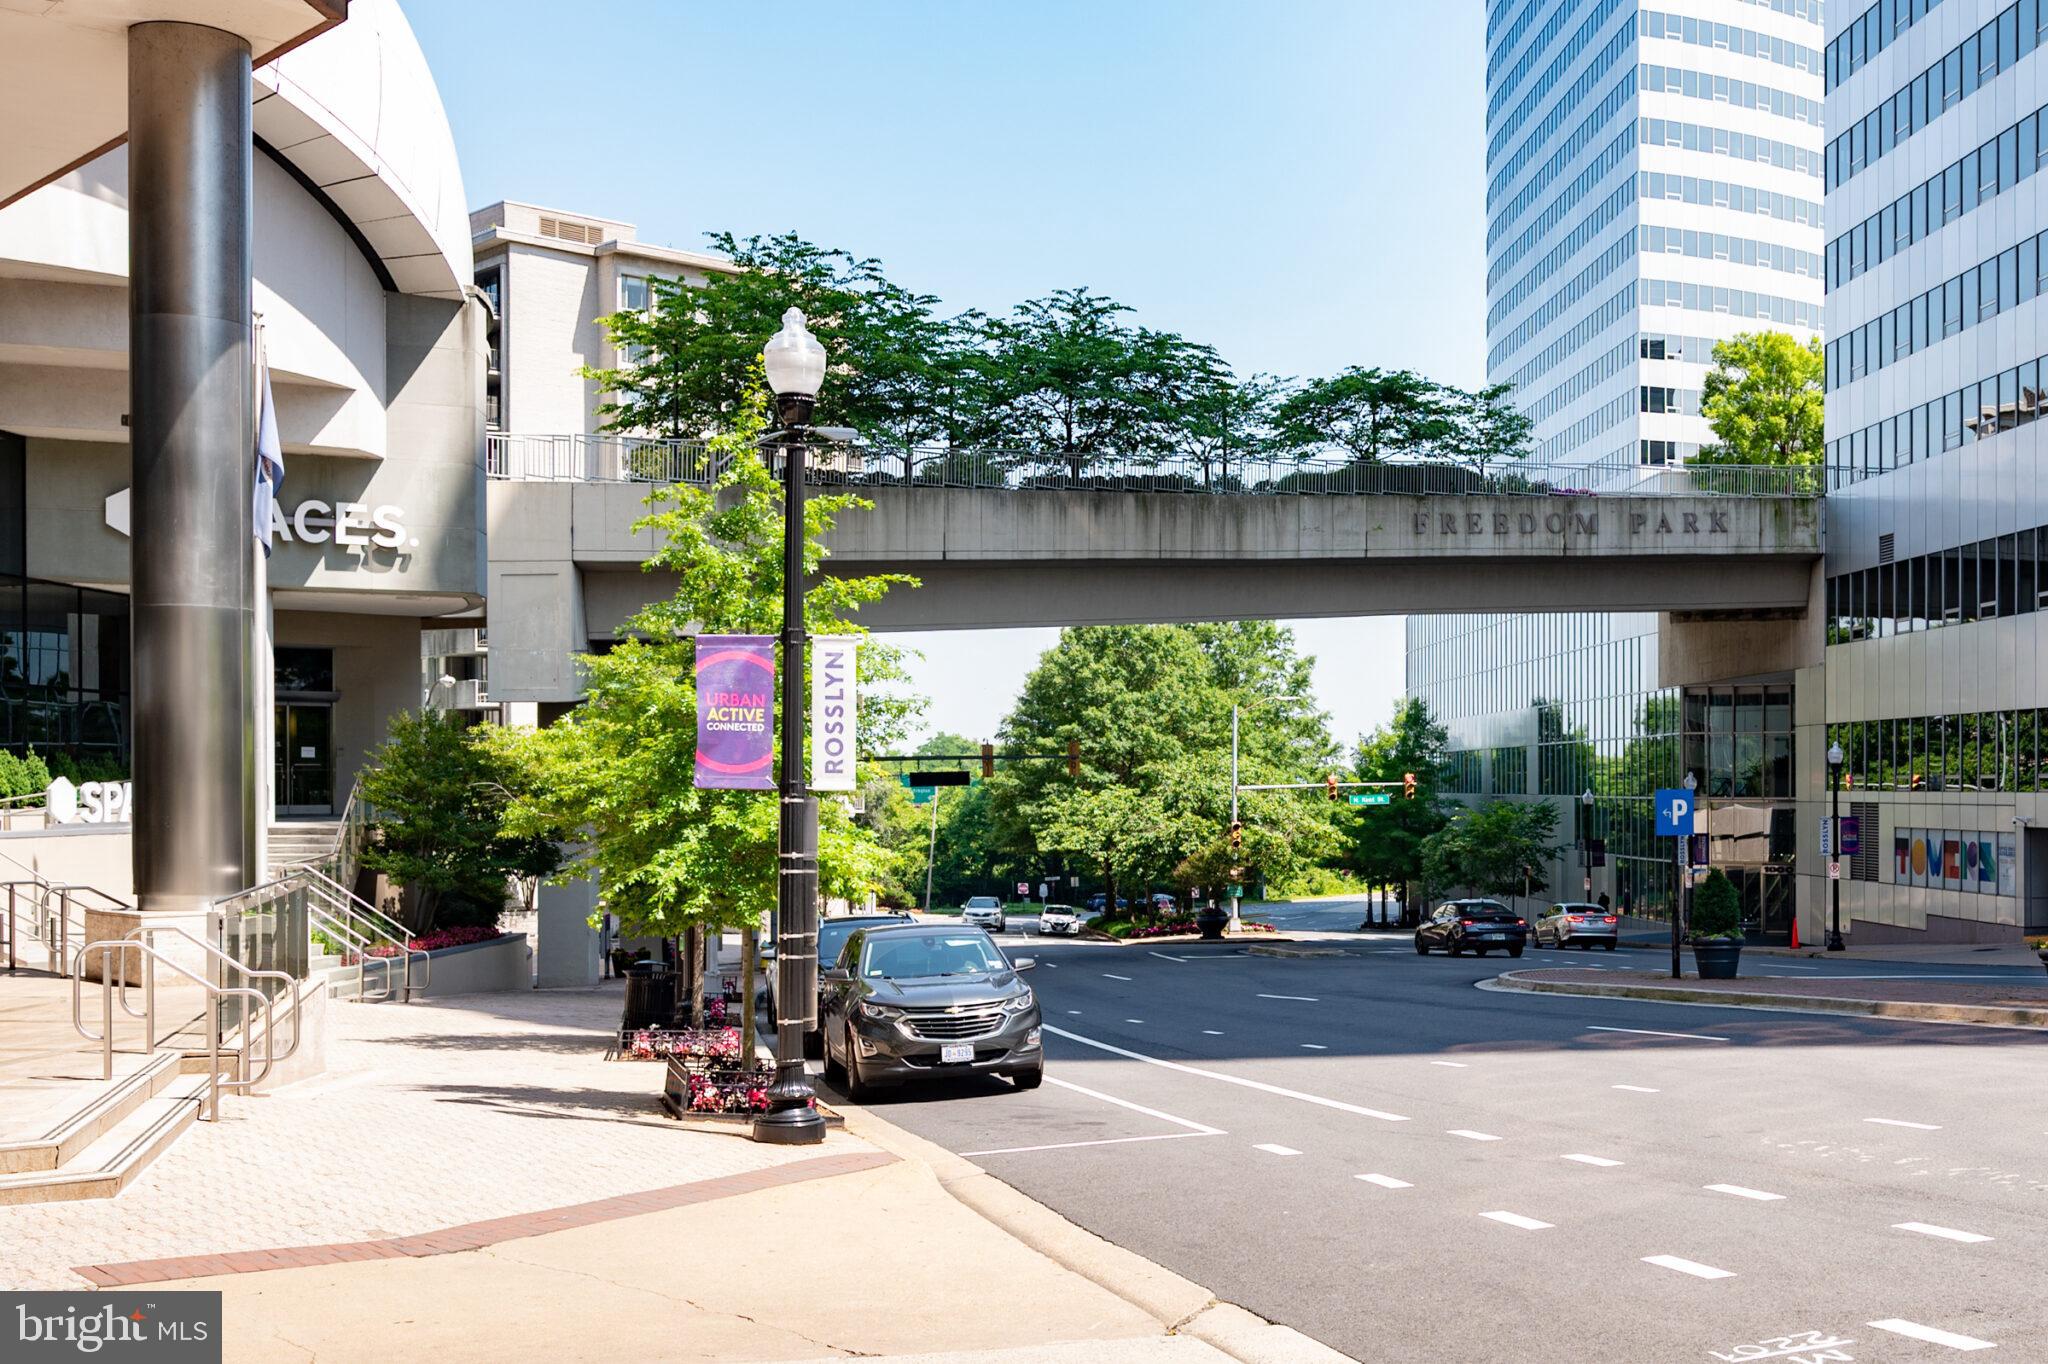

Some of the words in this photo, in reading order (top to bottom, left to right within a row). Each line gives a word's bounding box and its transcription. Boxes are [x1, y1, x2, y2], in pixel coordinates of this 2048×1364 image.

[1413, 512, 1599, 535] FREEDOM
[1630, 511, 1729, 534] PARK
[705, 692, 766, 707] URBAN
[706, 707, 765, 722] ACTIVE
[824, 652, 844, 774] ROSSLYN
[706, 722, 765, 732] CONNECTED
[1672, 799, 1688, 826] P
[1895, 838, 1996, 882] TOWERS
